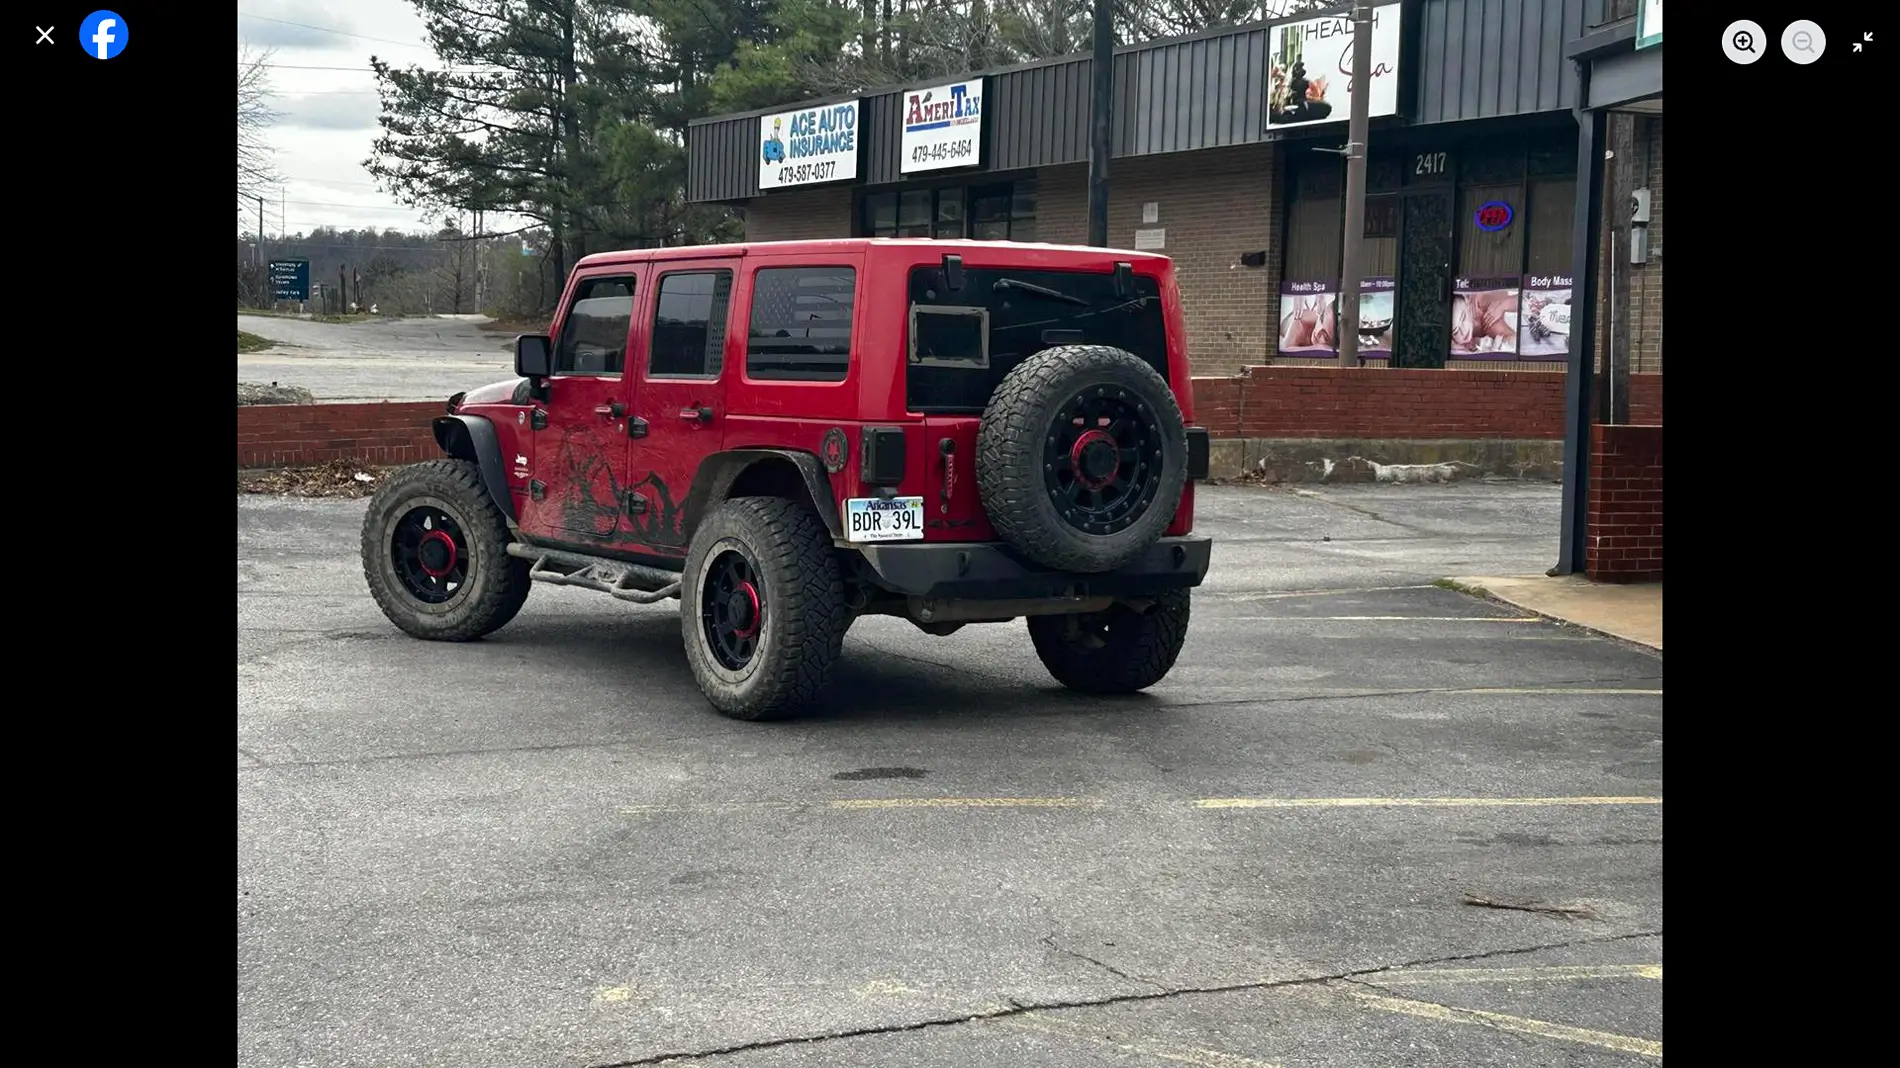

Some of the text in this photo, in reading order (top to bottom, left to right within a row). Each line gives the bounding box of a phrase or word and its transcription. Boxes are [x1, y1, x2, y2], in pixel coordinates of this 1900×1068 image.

[1305, 11, 1379, 41] HEALH
[1338, 38, 1393, 93] Sa
[790, 104, 856, 137] ACE AUTO
[789, 130, 855, 159] INSURANCE
[912, 139, 972, 163] 479-445-6464
[778, 161, 836, 184] 479-587-0377
[1415, 152, 1447, 175] 2417
[1291, 281, 1326, 292] Health Spa
[1530, 276, 1552, 289] Body
[865, 500, 907, 511] Arkansas
[852, 510, 921, 531] BDR 39L
